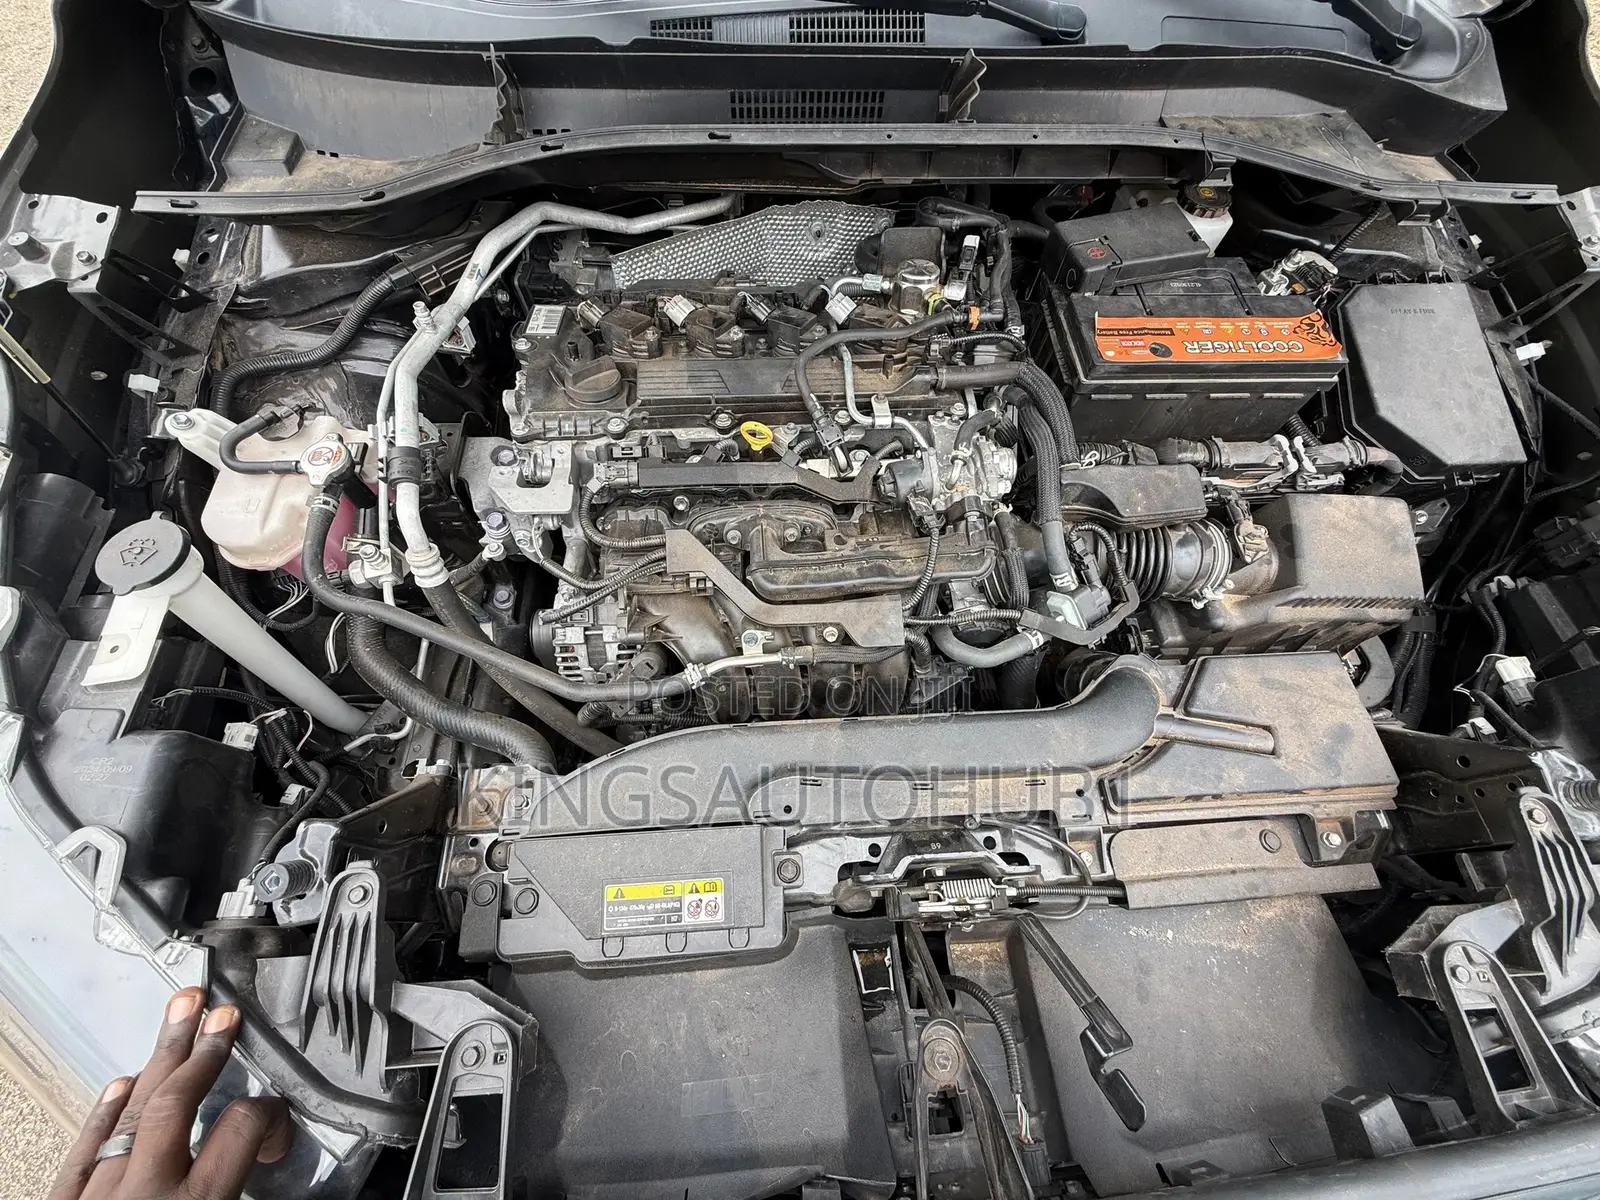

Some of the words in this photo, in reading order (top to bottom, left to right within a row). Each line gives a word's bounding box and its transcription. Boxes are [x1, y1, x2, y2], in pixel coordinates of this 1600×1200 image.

[1132, 328, 1172, 336] Maintenance
[1182, 340, 1304, 354] COOLTIGER
[92, 757, 115, 766] CR2
